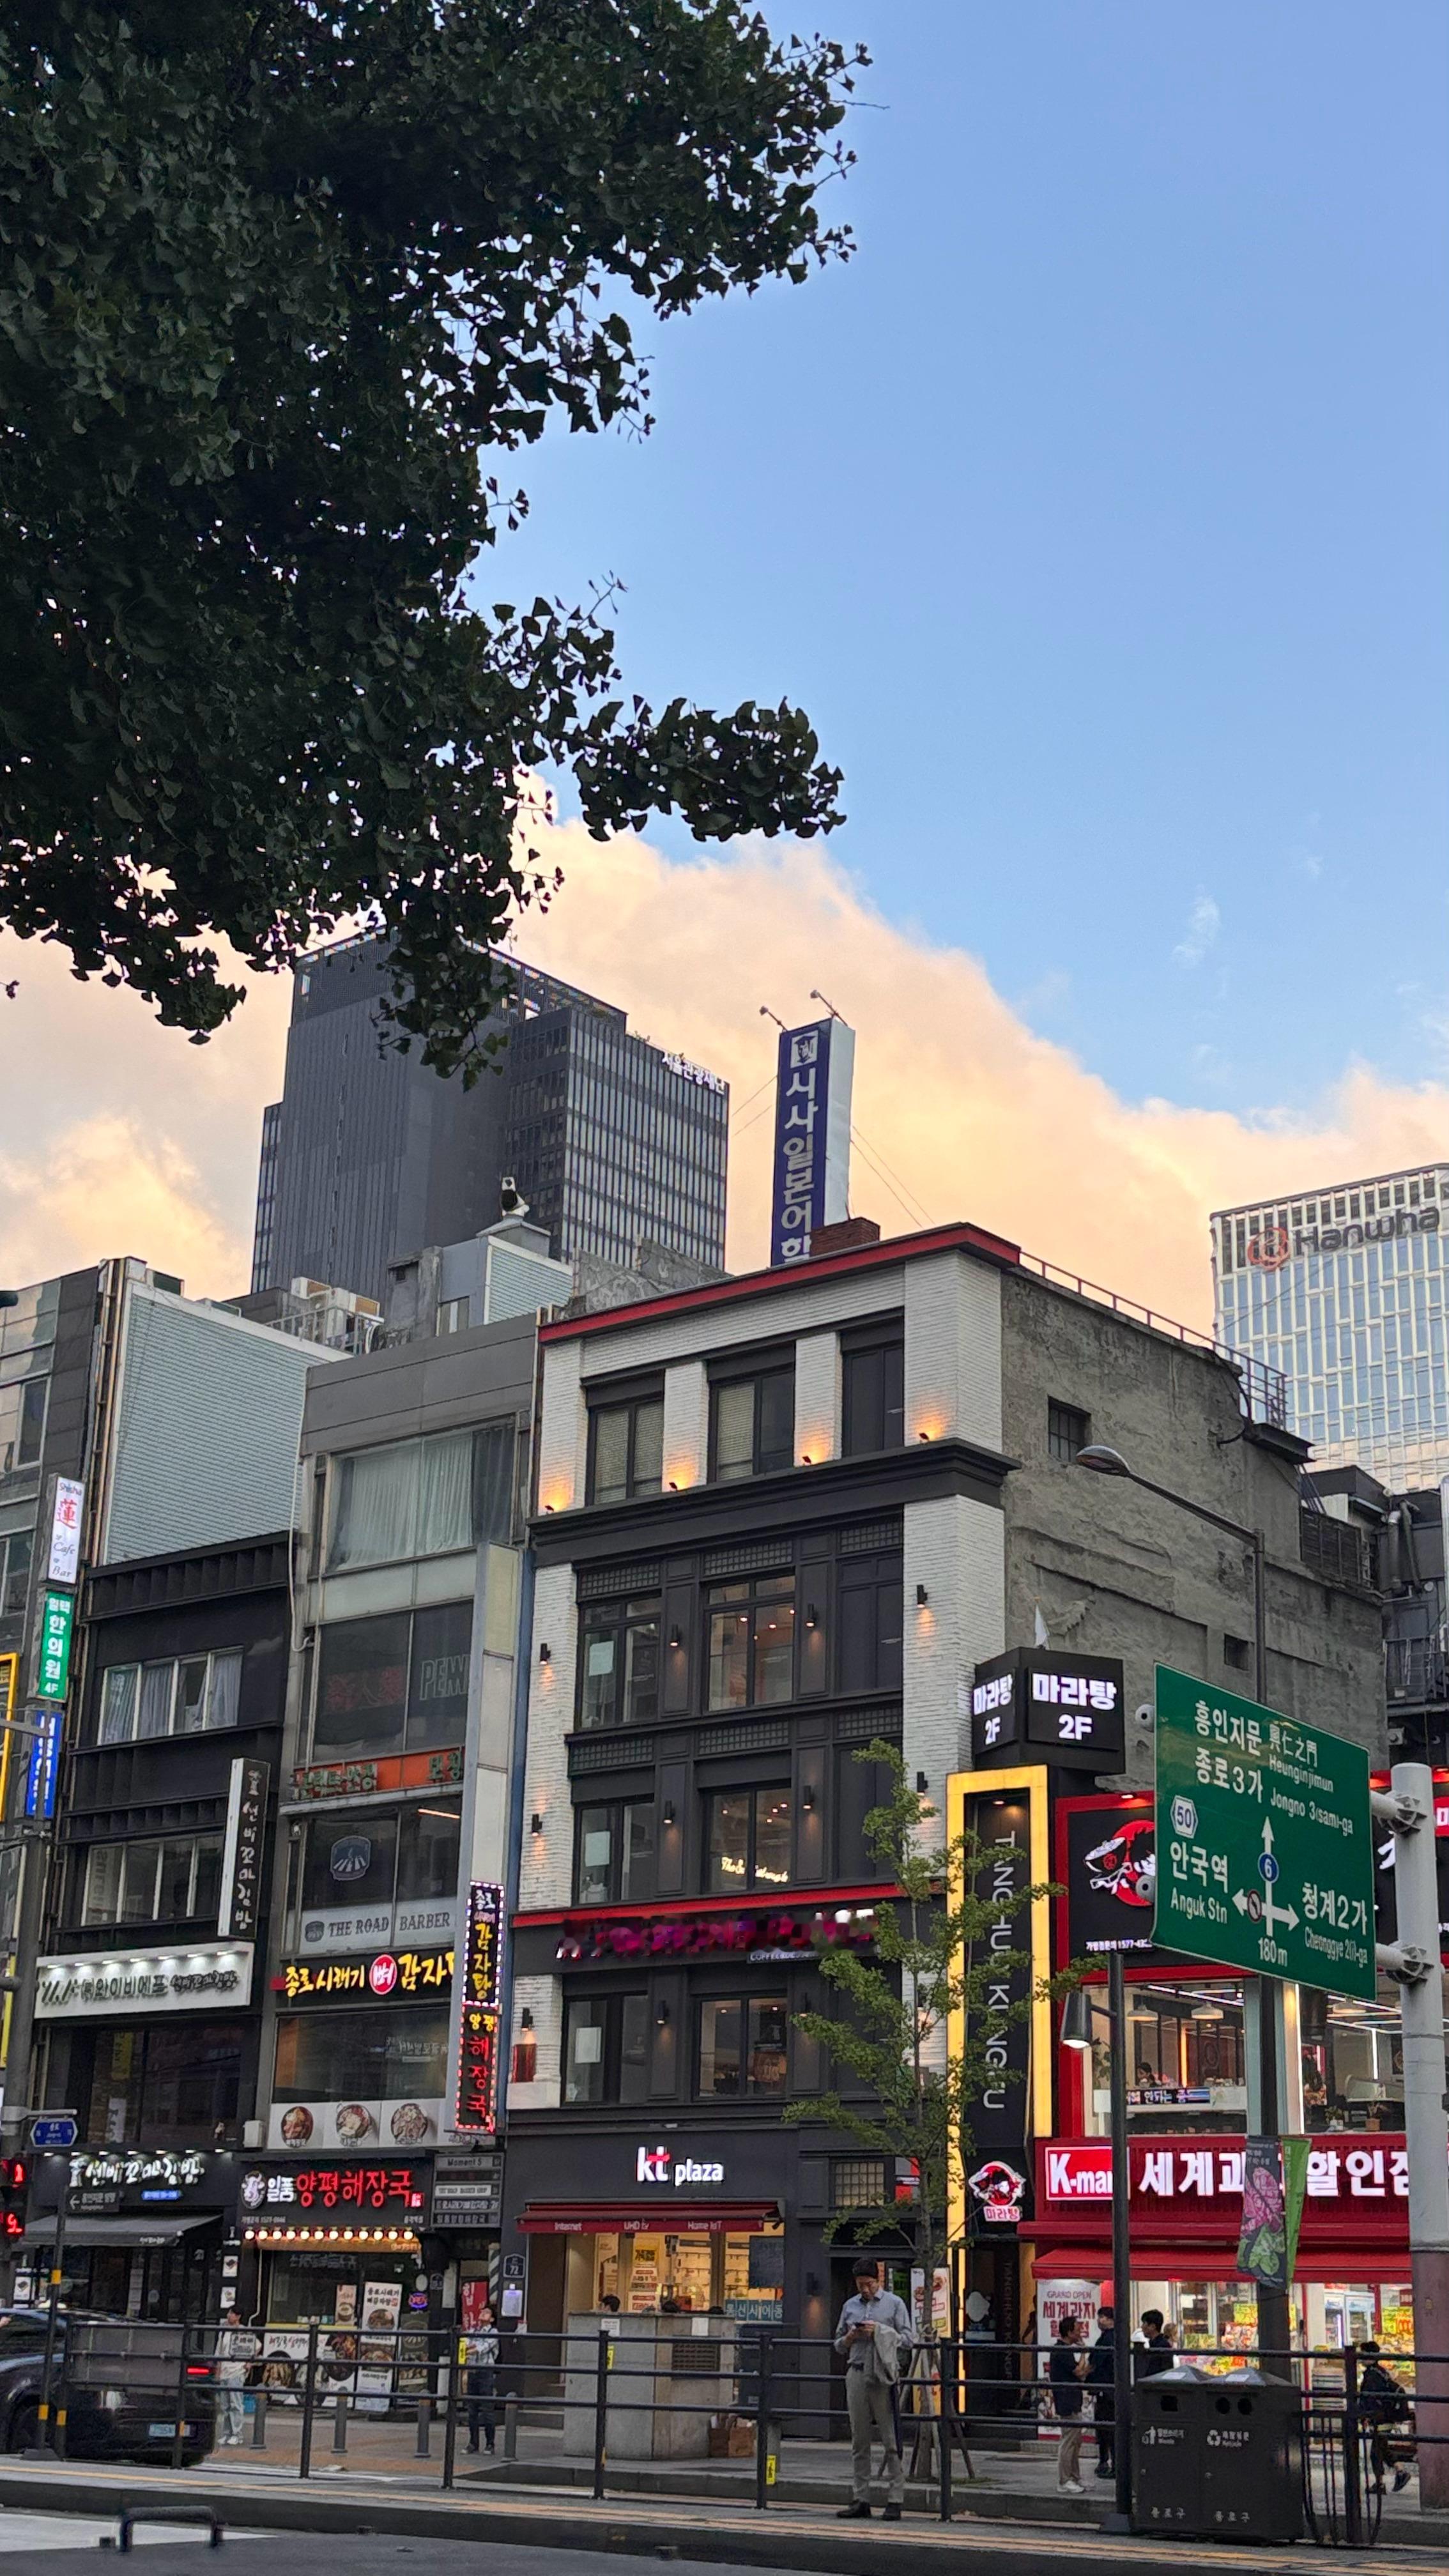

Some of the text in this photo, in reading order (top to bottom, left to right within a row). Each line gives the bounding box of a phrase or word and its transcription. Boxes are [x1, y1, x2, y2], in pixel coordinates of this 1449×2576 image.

[661, 1052, 725, 1095] 서울관광재단
[1295, 1206, 1441, 1256] Hanwha
[53, 1541, 76, 1556] Cafe
[52, 1566, 72, 1578] Bar
[45, 1614, 66, 1680] 한의원
[44, 1682, 59, 1694] 4F
[972, 1673, 1013, 1716] 마라탕
[1032, 1673, 1117, 1711] 마라탕
[985, 1717, 1001, 1745] 2F
[1058, 1713, 1092, 1741] 2F
[1195, 1699, 1262, 1757] 흥인지문
[1195, 1746, 1263, 1804] 종로3가
[1269, 1753, 1334, 1793] Heunginjimun
[1176, 1805, 1192, 1828] 50
[1270, 1786, 1306, 1818] Jongno
[1170, 1841, 1229, 1894] 안국역
[1264, 1858, 1272, 1878] 6
[475, 1889, 496, 1910] 종로
[1170, 1886, 1228, 1924] Anguk Stn
[1301, 1881, 1368, 1936] 청계2가
[328, 1912, 451, 1938] THE ROAD BARBER
[285, 1964, 365, 1998] 종로시래기
[398, 1951, 454, 1991] 감자
[471, 1923, 493, 2000] 감자탕
[469, 2013, 494, 2032] 양평
[466, 2035, 489, 2118] 해장국
[84, 2156, 203, 2186] 선비꼬마김밥
[636, 2145, 724, 2186] kt plaza
[1050, 2153, 1112, 2195] K-mar
[1138, 2150, 1409, 2198] 세계과할인
[266, 2175, 295, 2202] 일품
[296, 2168, 413, 2208] 양평해장국
[554, 2221, 582, 2231] Internet
[623, 2221, 640, 2230] UHD
[687, 2220, 707, 2230] Home
[509, 2265, 519, 2275] 72
[1043, 2301, 1096, 2319] 세계과자
[1046, 2290, 1092, 2299] GRAND OPEN
[1050, 2320, 1089, 2338] 할점
